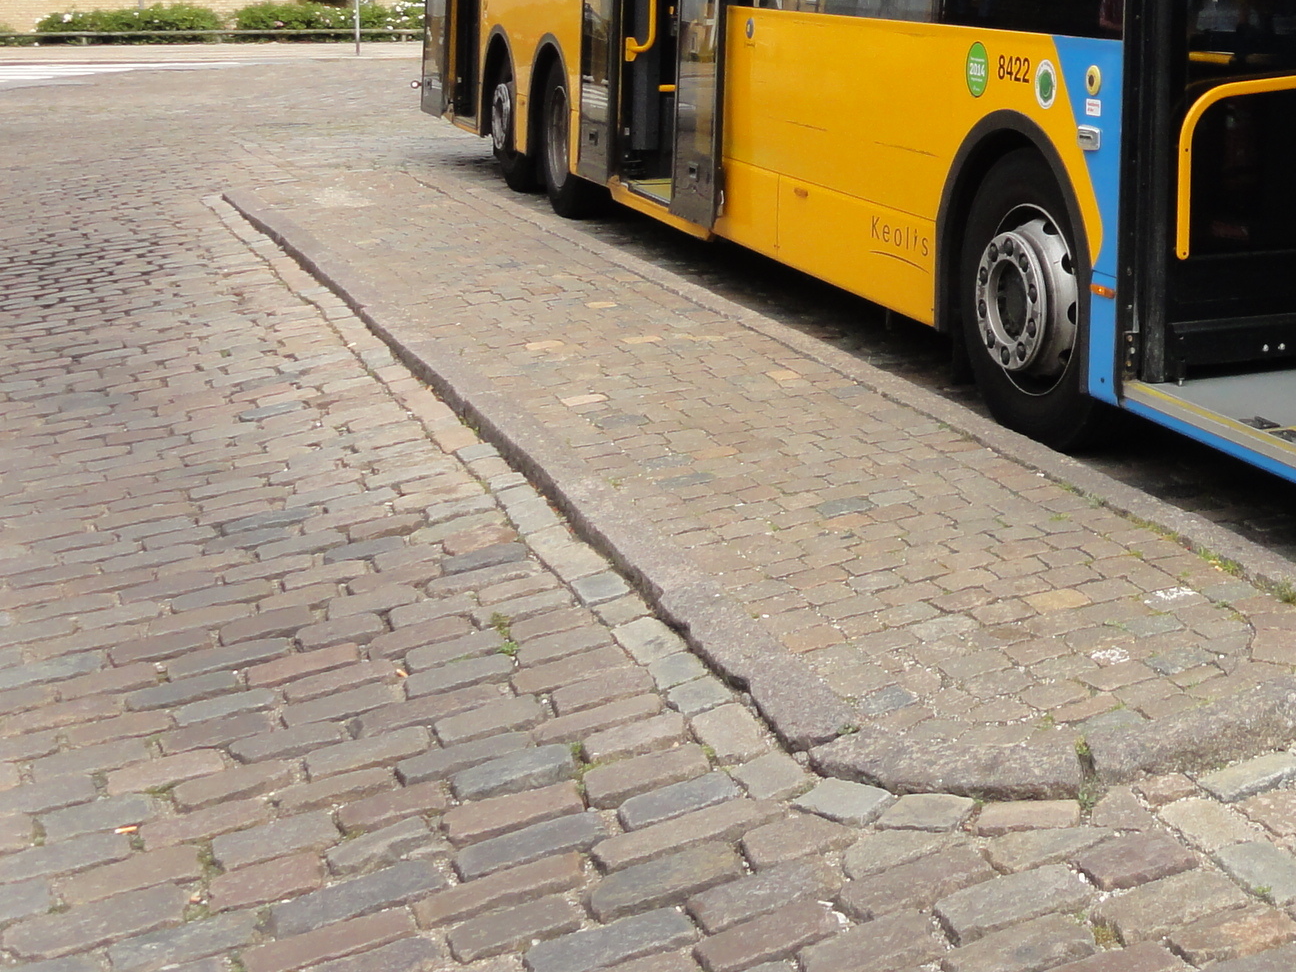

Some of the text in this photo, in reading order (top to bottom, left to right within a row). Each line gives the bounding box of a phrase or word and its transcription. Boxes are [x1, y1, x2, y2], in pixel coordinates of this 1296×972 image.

[969, 62, 986, 77] 2014
[997, 54, 1031, 84] 8422
[871, 215, 929, 257] Keolis
